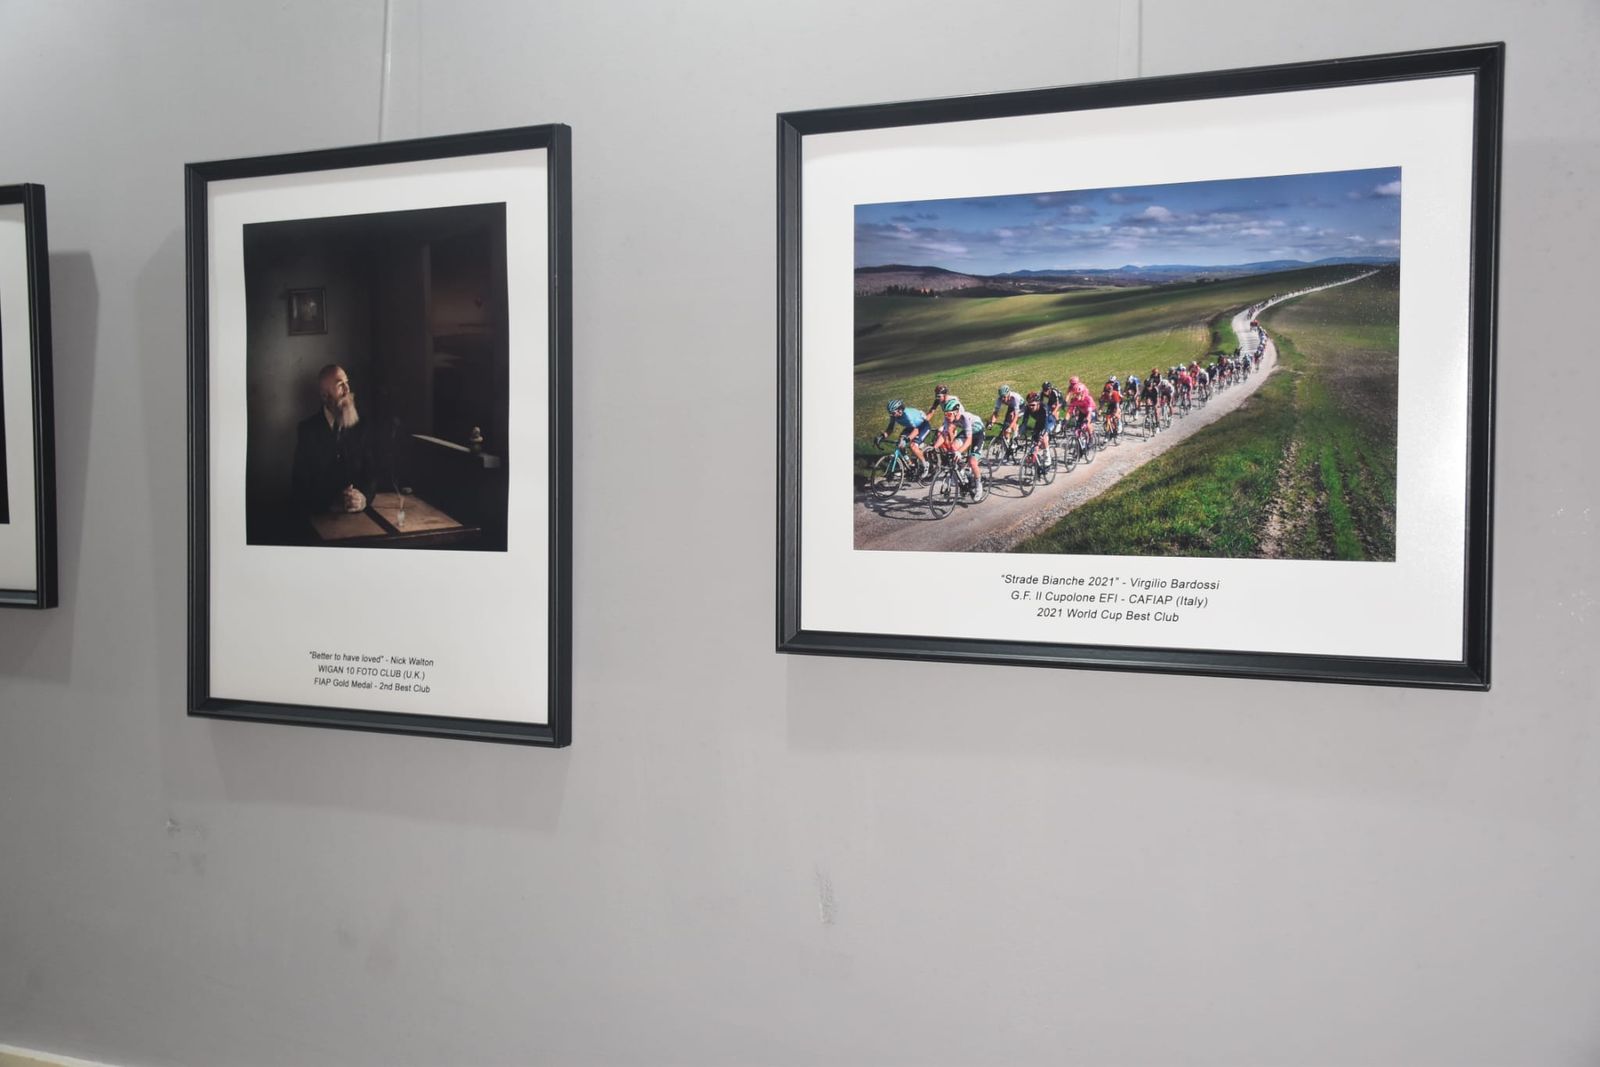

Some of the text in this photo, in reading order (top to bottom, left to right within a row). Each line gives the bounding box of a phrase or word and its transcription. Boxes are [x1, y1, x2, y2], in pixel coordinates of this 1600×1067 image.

[1042, 575, 1084, 586] Bianche
[1130, 578, 1167, 590] Virgilio
[1170, 579, 1220, 590] Bardossi
[1011, 591, 1031, 600] G.F.
[1045, 592, 1095, 603] Cupolone
[1100, 594, 1117, 602] EFI
[1129, 595, 1173, 605] CAFIAP
[1176, 596, 1208, 608] (Italy)
[1037, 608, 1179, 622] 2021 World Cup Best Club
[343, 653, 360, 662] have
[408, 657, 434, 666] Walton
[318, 665, 344, 674] WIGAN
[347, 666, 354, 674] 10
[356, 667, 378, 676] FOTO
[380, 669, 401, 677] CLUB
[314, 677, 331, 686] FIAP
[333, 679, 349, 687] Gold
[351, 680, 372, 689] Medal
[395, 683, 411, 692] Best
[413, 684, 430, 693] Club
